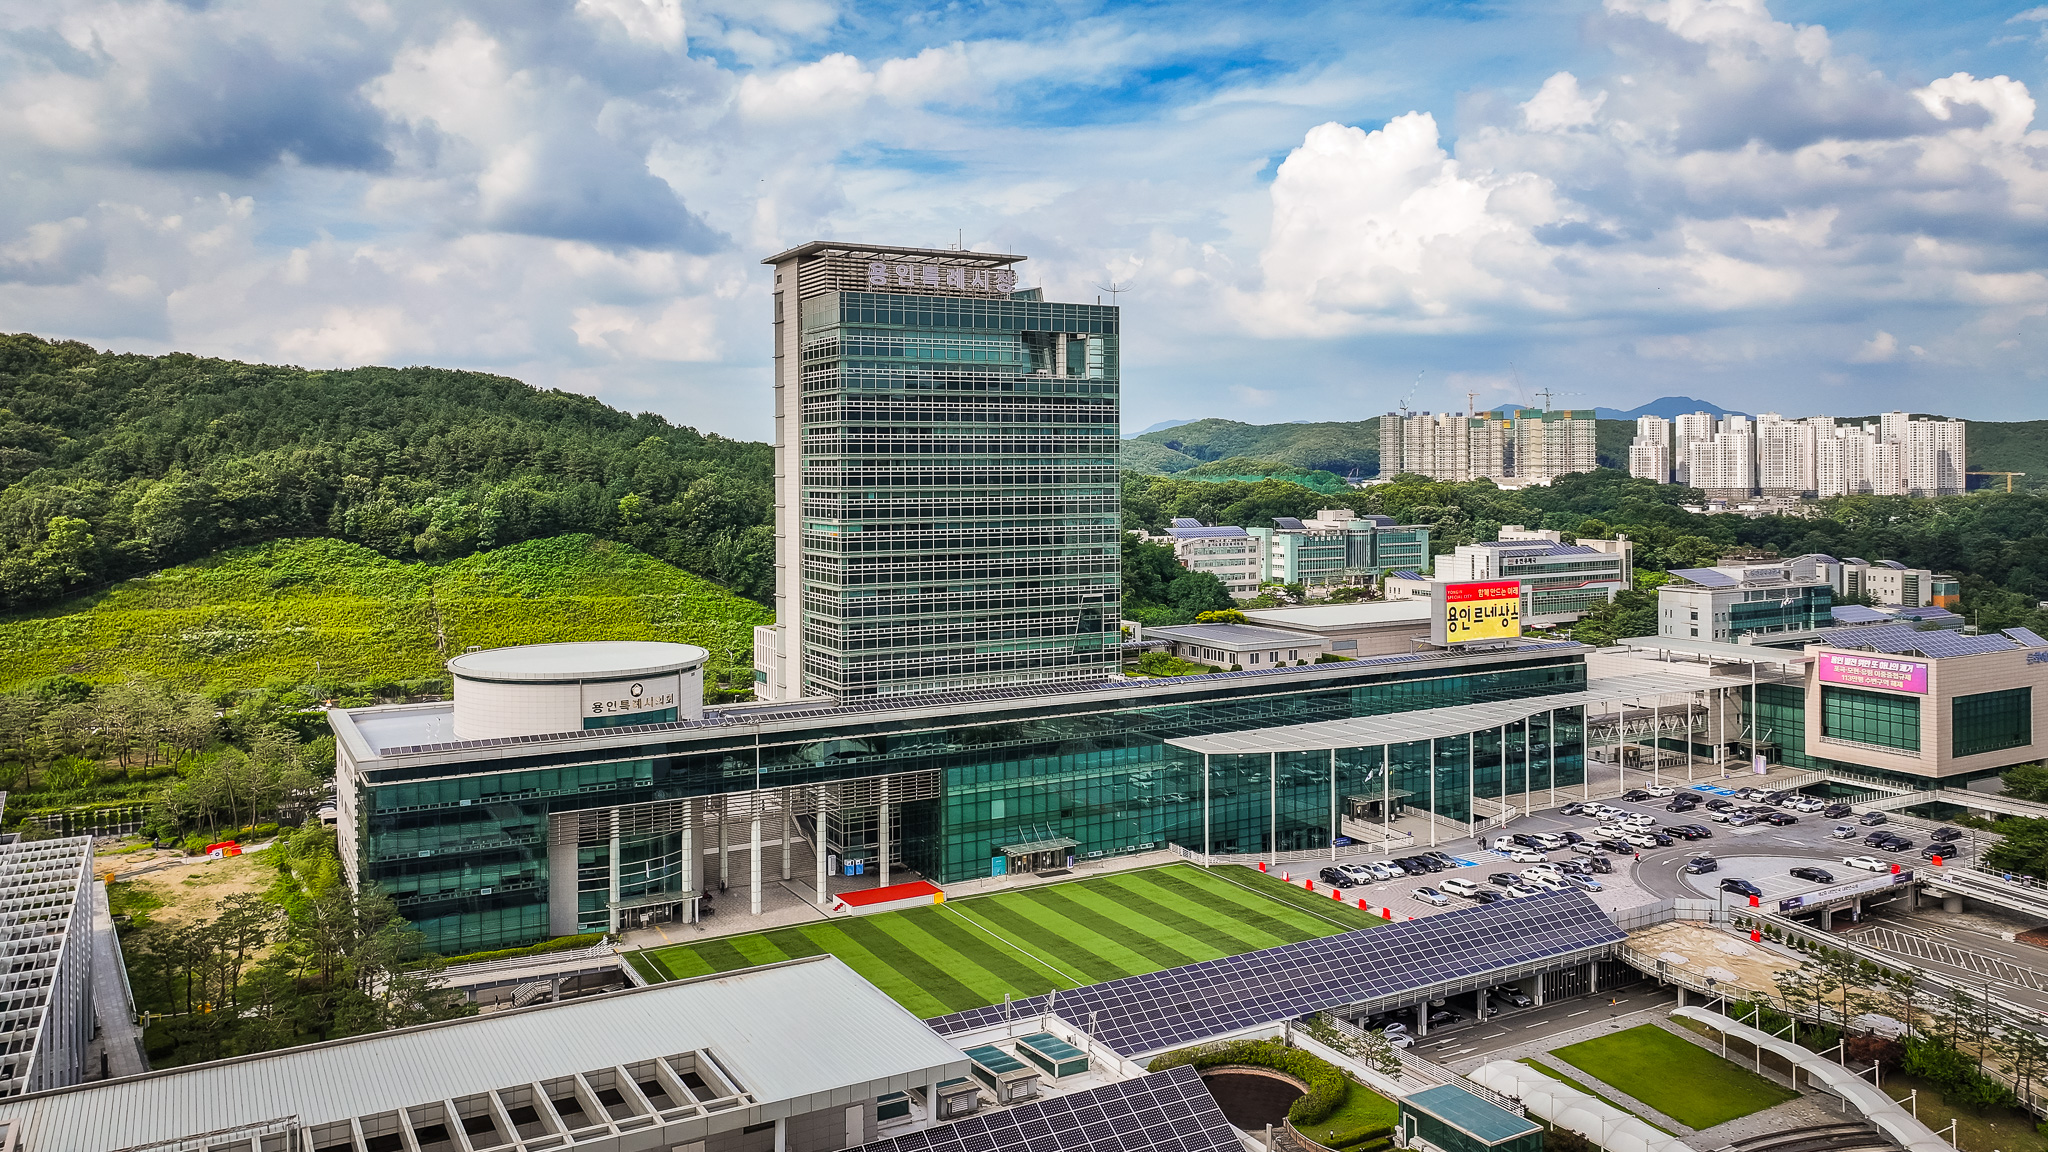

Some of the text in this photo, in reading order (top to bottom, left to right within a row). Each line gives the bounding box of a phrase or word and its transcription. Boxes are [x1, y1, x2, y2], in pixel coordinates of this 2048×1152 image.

[868, 262, 1018, 292] 용인특례시청
[1477, 586, 1518, 598] 함께 만드는 미래
[1447, 602, 1519, 632] 용인 르네상스
[1830, 656, 1844, 665] 용인
[592, 693, 674, 714] 용인특례시의회
